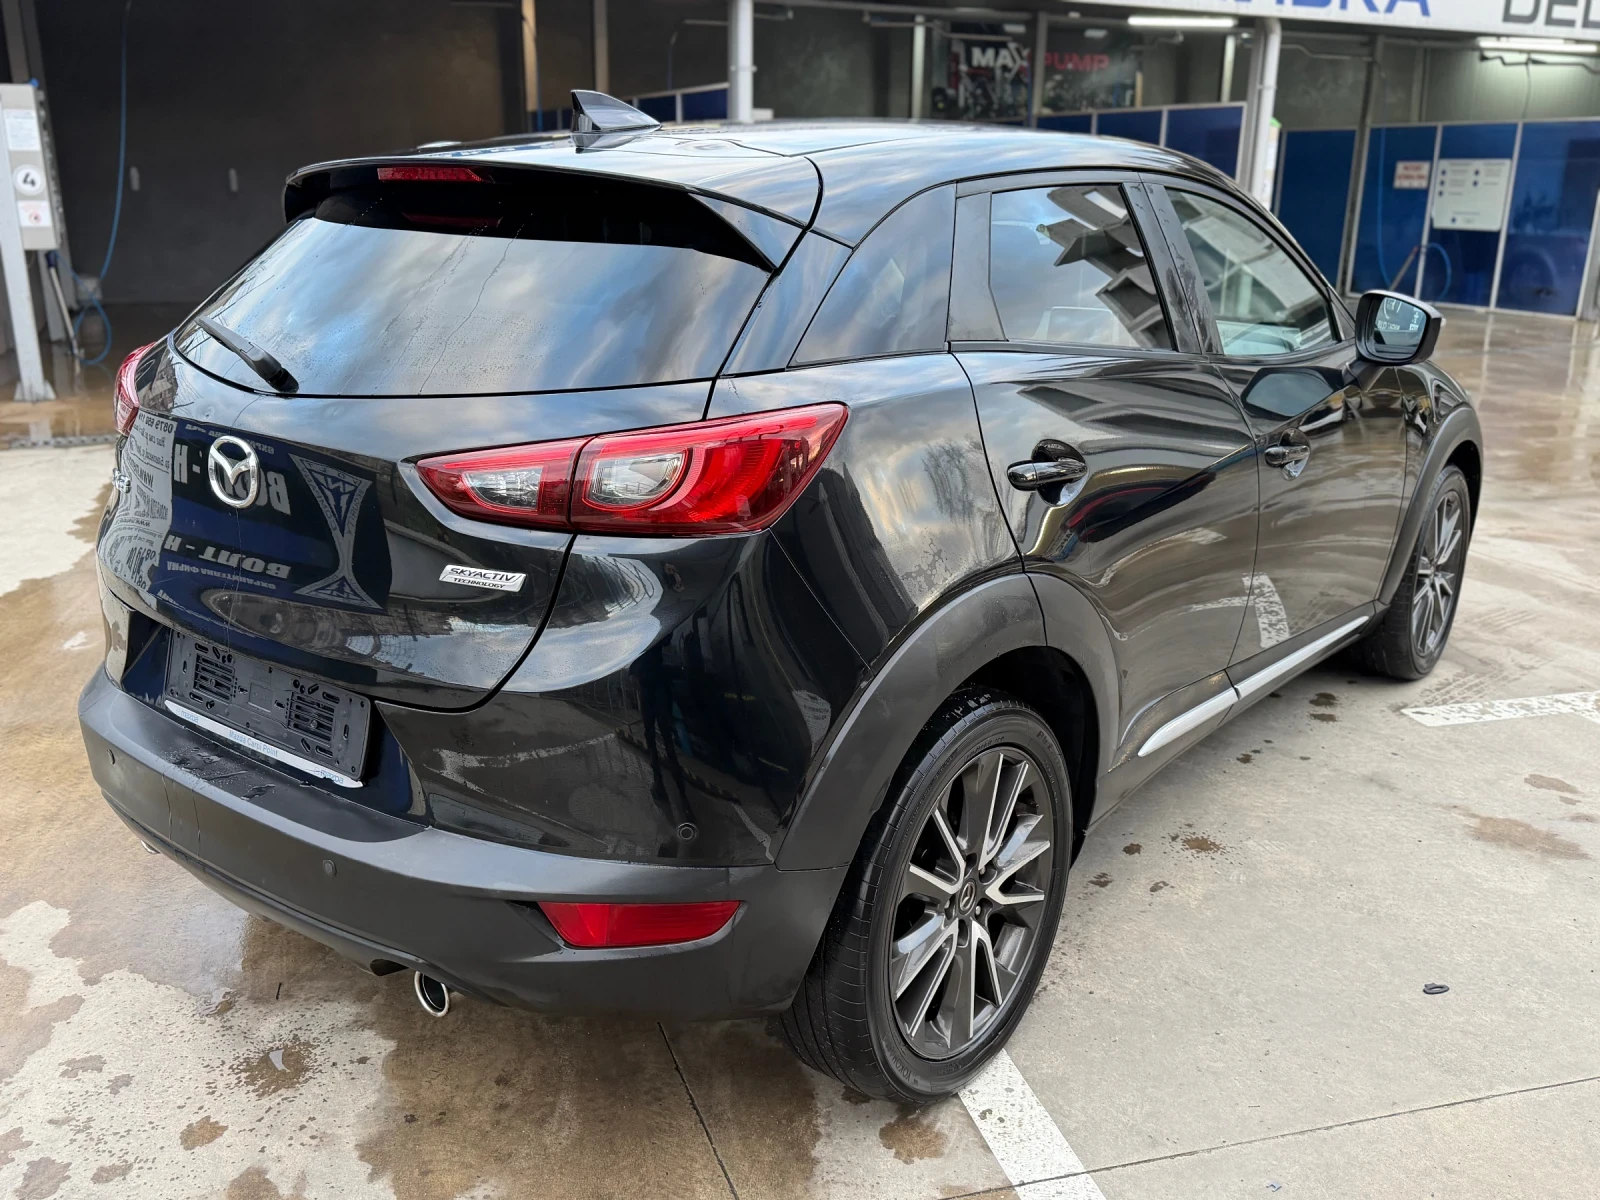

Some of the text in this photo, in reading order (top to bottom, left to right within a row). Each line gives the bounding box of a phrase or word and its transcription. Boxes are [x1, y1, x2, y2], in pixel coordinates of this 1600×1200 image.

[22, 172, 36, 188] 4
[449, 567, 516, 582] SKYACTIV
[453, 577, 506, 589] TECHNOLOGY
[229, 729, 278, 757] Mazda Carpi Point
